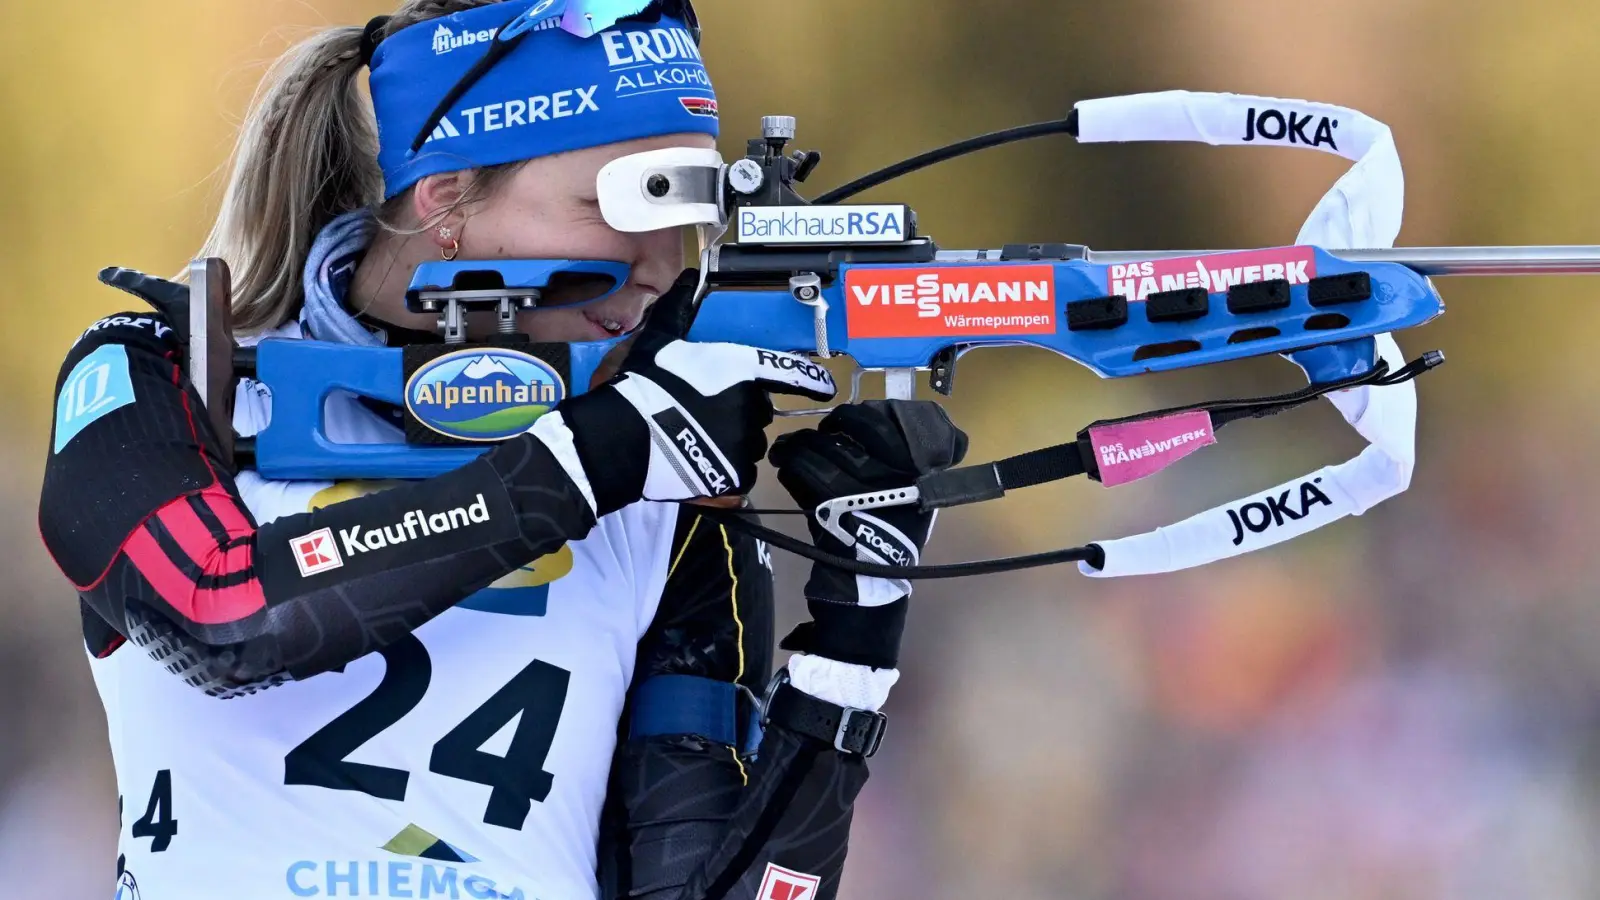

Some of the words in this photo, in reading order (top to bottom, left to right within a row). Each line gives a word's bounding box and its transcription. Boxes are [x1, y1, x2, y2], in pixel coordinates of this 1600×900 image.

[599, 27, 702, 66] ERDIN
[615, 68, 713, 92] ALKOHO
[461, 85, 600, 135] TERREX
[1242, 107, 1338, 151] JOKA
[1112, 262, 1154, 279] DAS
[851, 274, 1049, 318] VIESSMANN
[944, 314, 1050, 329] Wärmepumpen
[415, 380, 556, 409] Alpenhain
[1100, 443, 1124, 454] DAS
[339, 493, 491, 557] Kaufland
[1227, 477, 1333, 546] JOKA
[283, 632, 572, 831] 24
[286, 860, 539, 900] CHIEMGA
